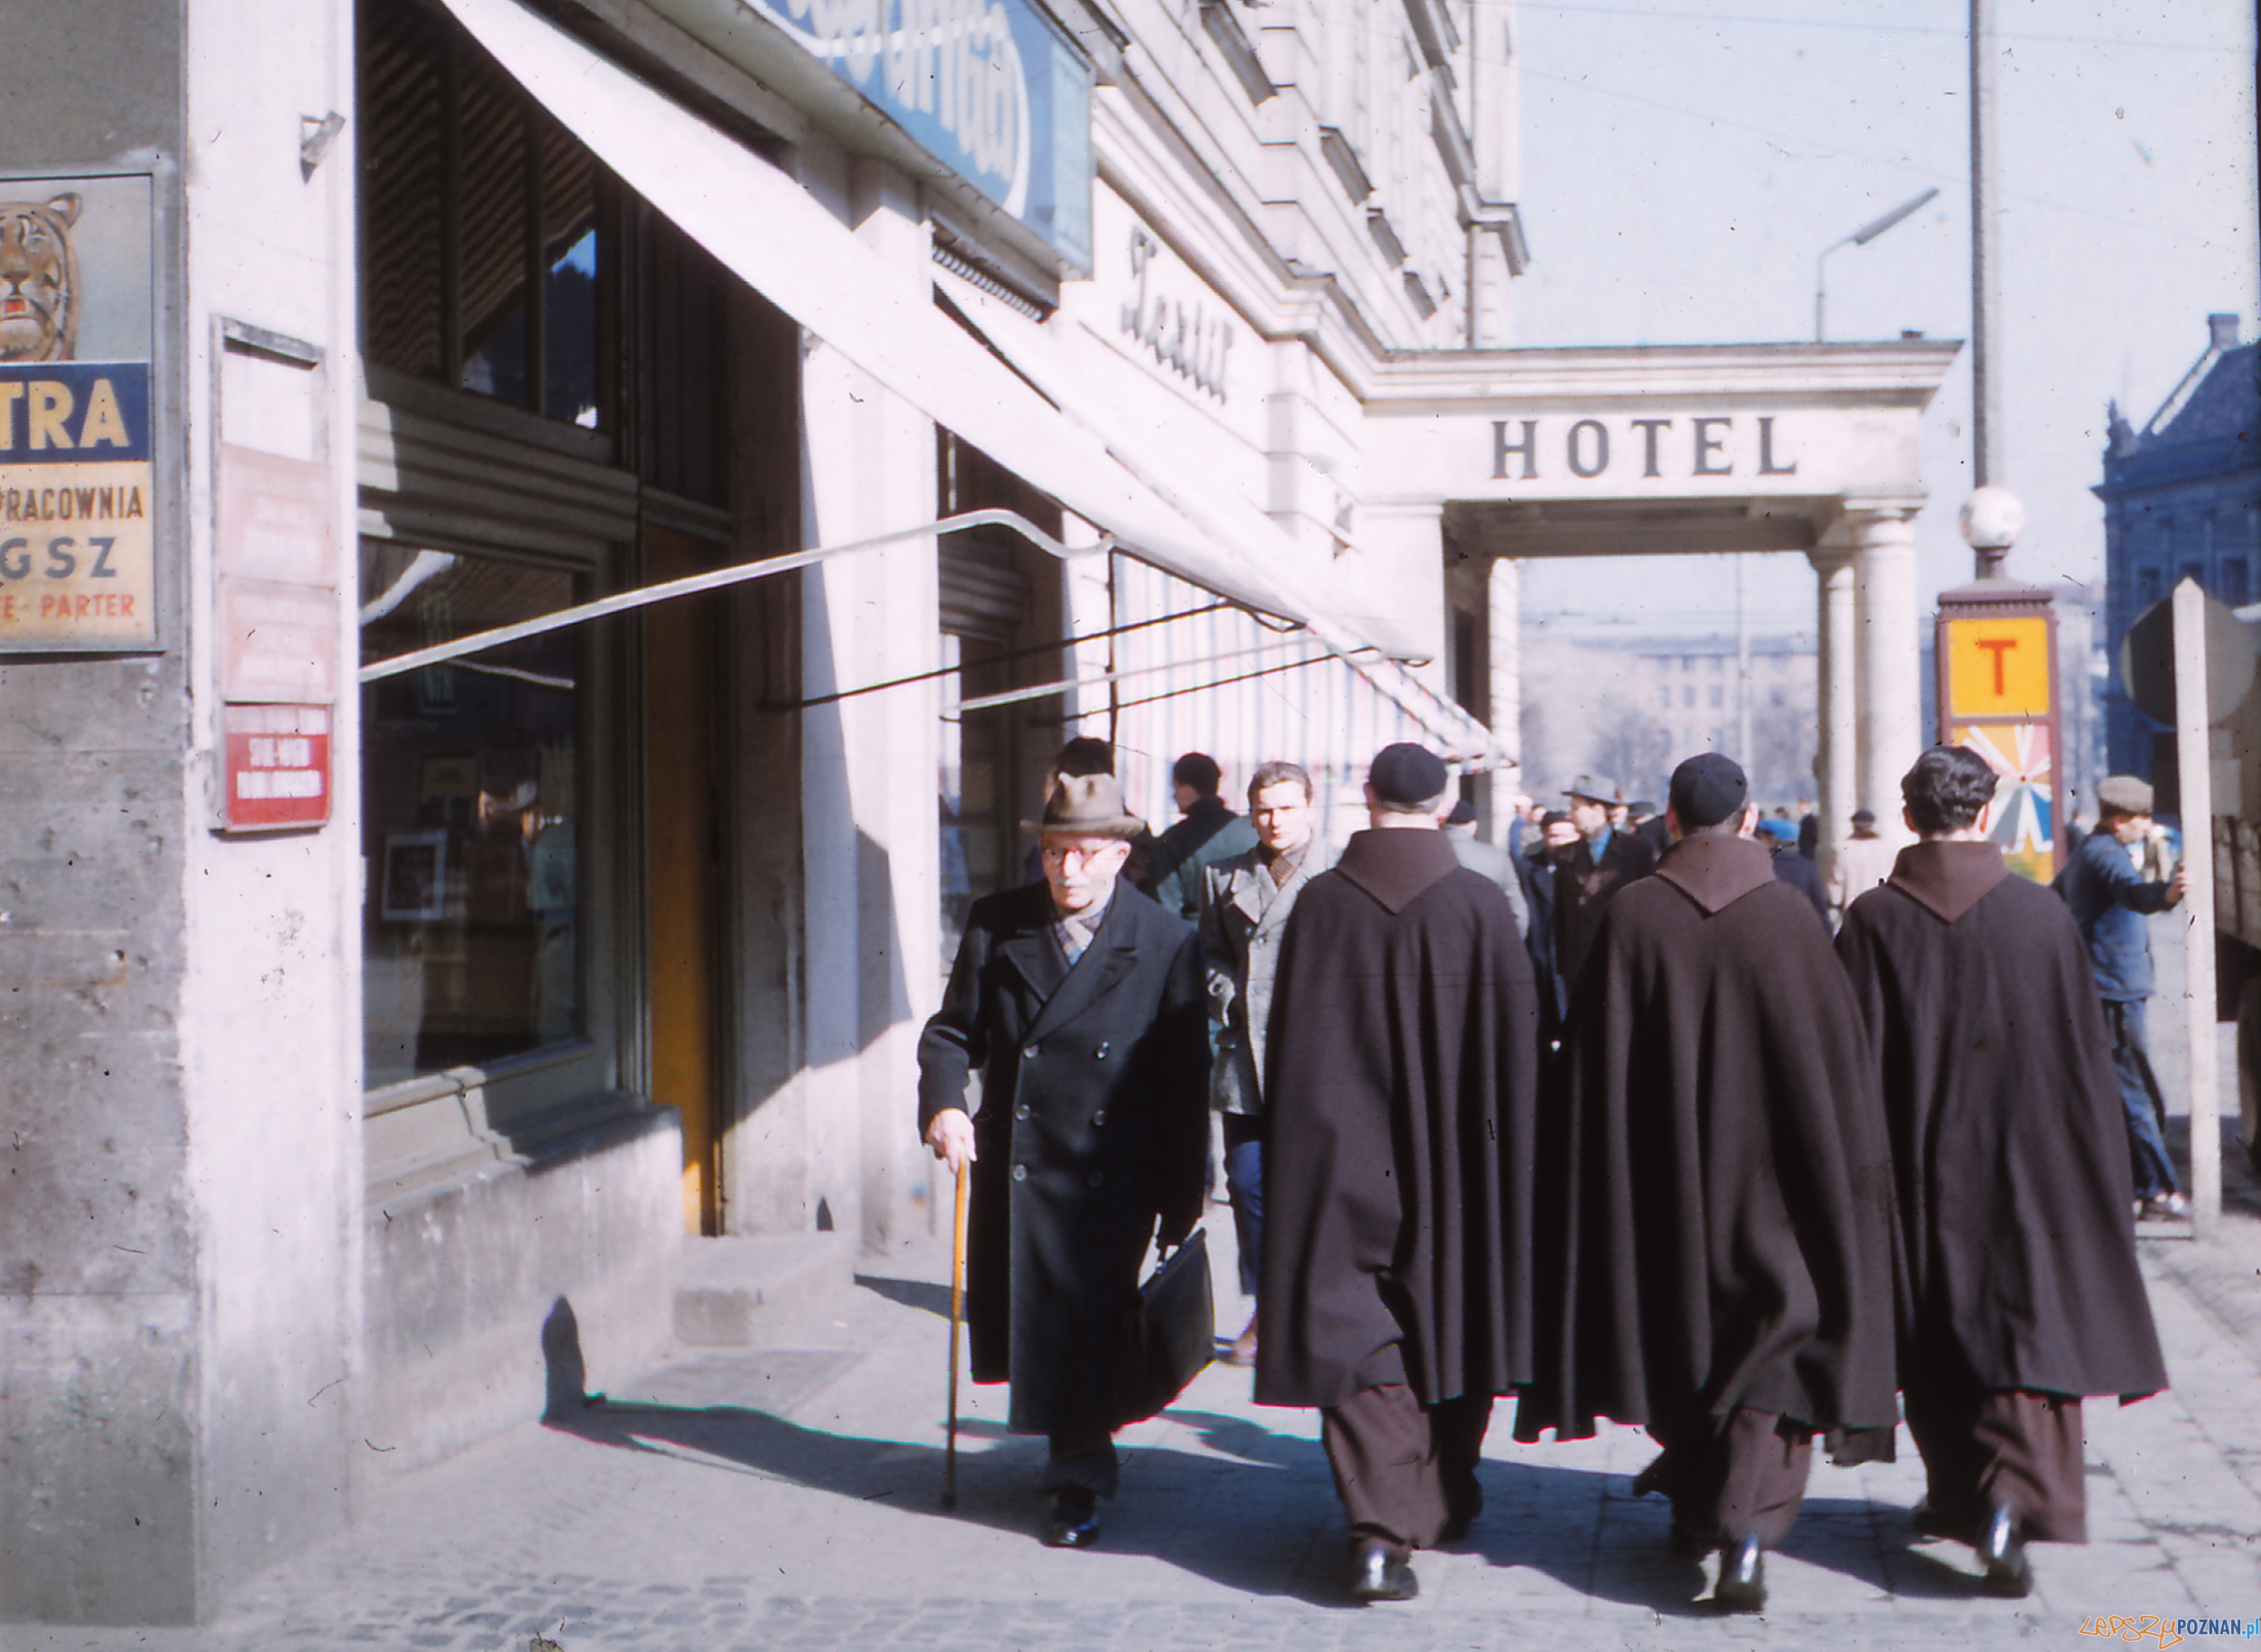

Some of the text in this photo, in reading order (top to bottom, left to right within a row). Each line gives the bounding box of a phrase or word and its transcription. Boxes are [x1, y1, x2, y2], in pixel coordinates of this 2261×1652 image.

[1490, 417, 1798, 479] HOTEL
[0, 536, 117, 580] GSZ
[41, 593, 135, 618] PARTER
[1978, 640, 2017, 695] T
